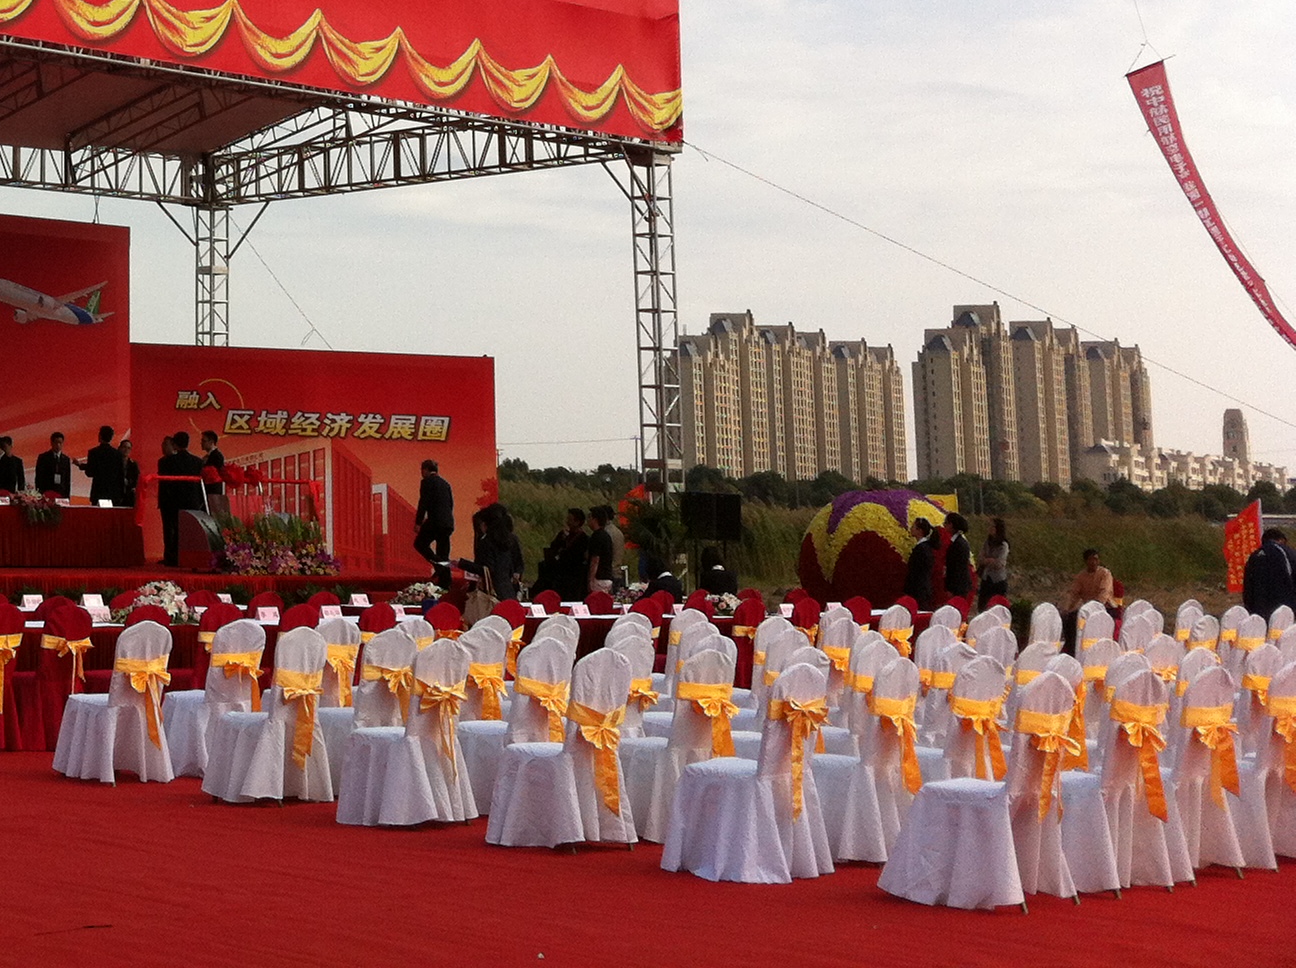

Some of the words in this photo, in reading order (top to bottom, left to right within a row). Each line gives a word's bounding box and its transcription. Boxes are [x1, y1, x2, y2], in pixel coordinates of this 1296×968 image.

[175, 390, 222, 410] 融入
[223, 409, 451, 442] 区域经济发展圈
